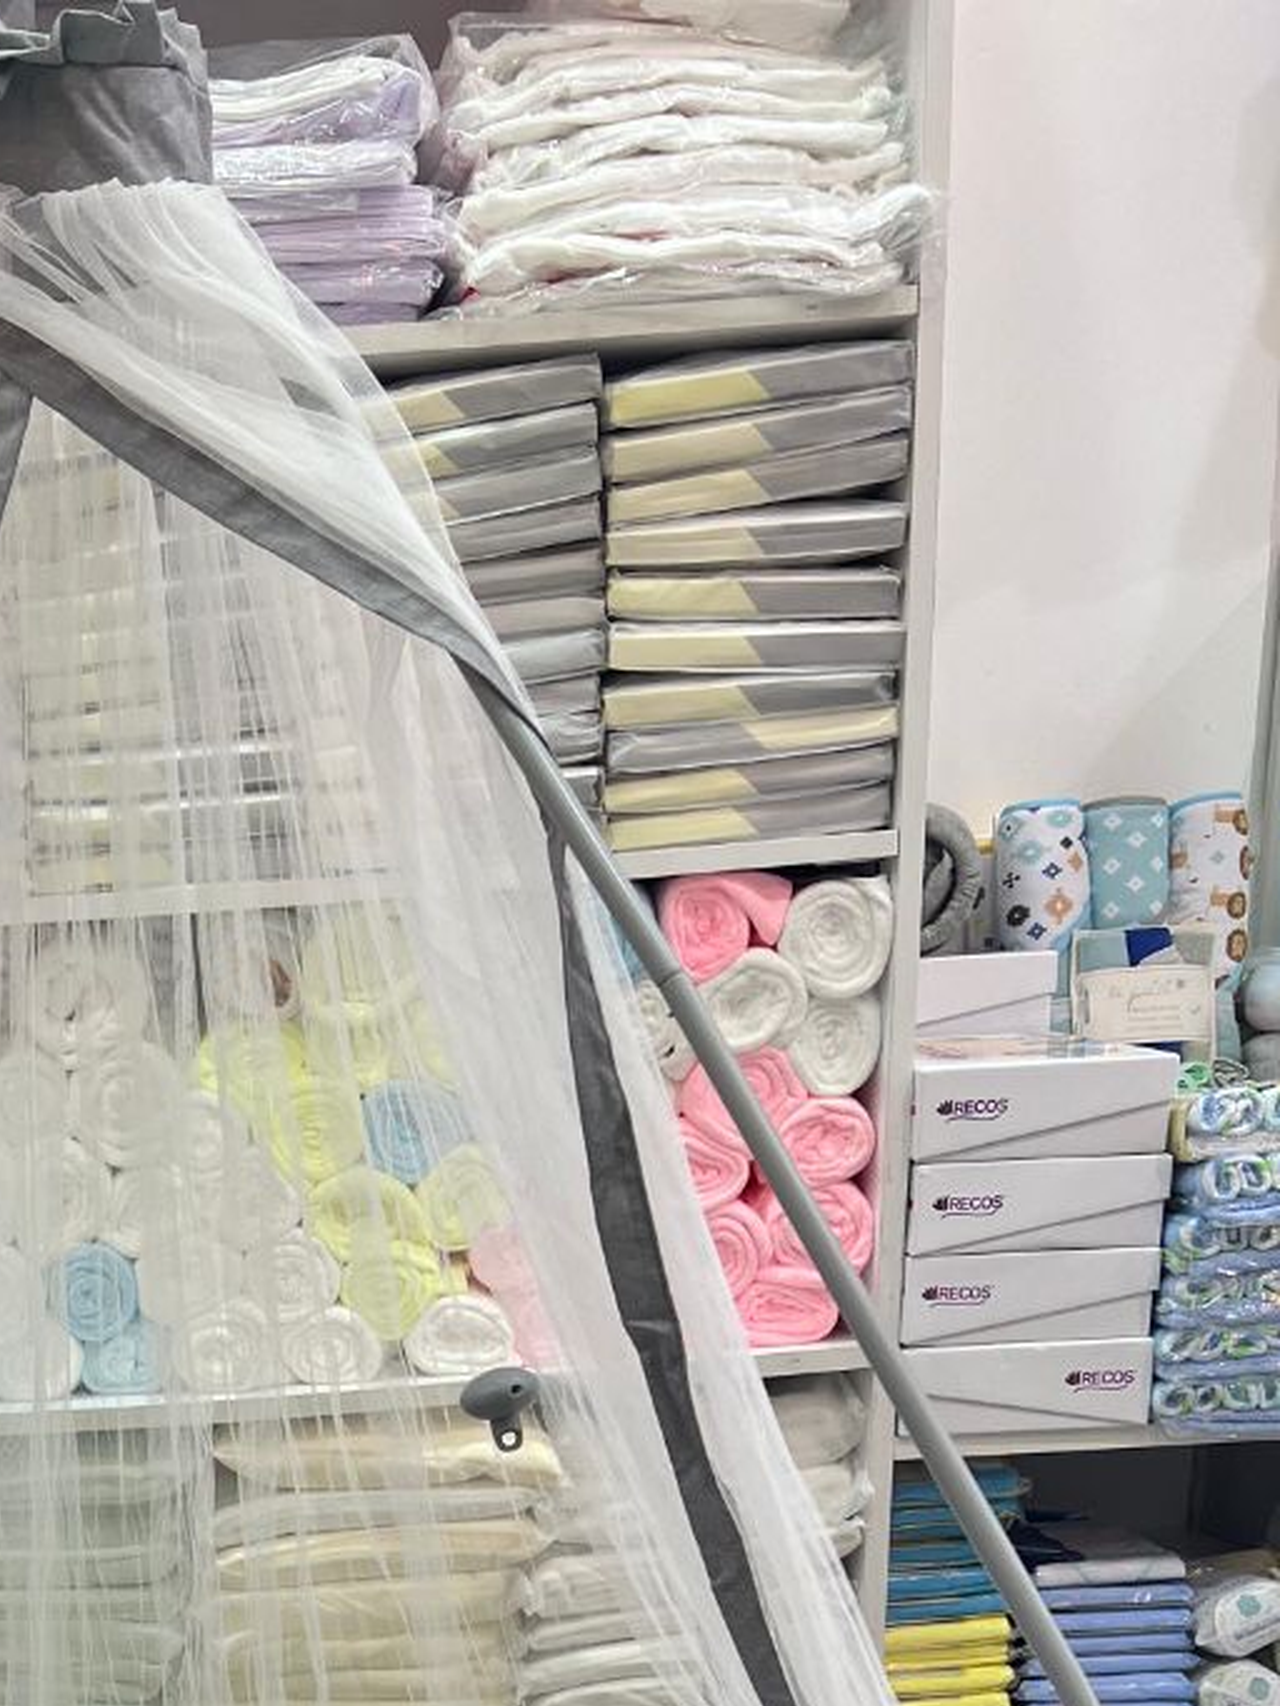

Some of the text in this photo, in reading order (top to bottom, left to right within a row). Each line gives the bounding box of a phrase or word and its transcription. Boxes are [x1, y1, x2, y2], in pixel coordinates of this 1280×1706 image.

[954, 1098, 1009, 1115] RECOS
[948, 1195, 1004, 1212] RECOS
[938, 1284, 992, 1301] RECOS
[1082, 1369, 1136, 1387] RECOS
